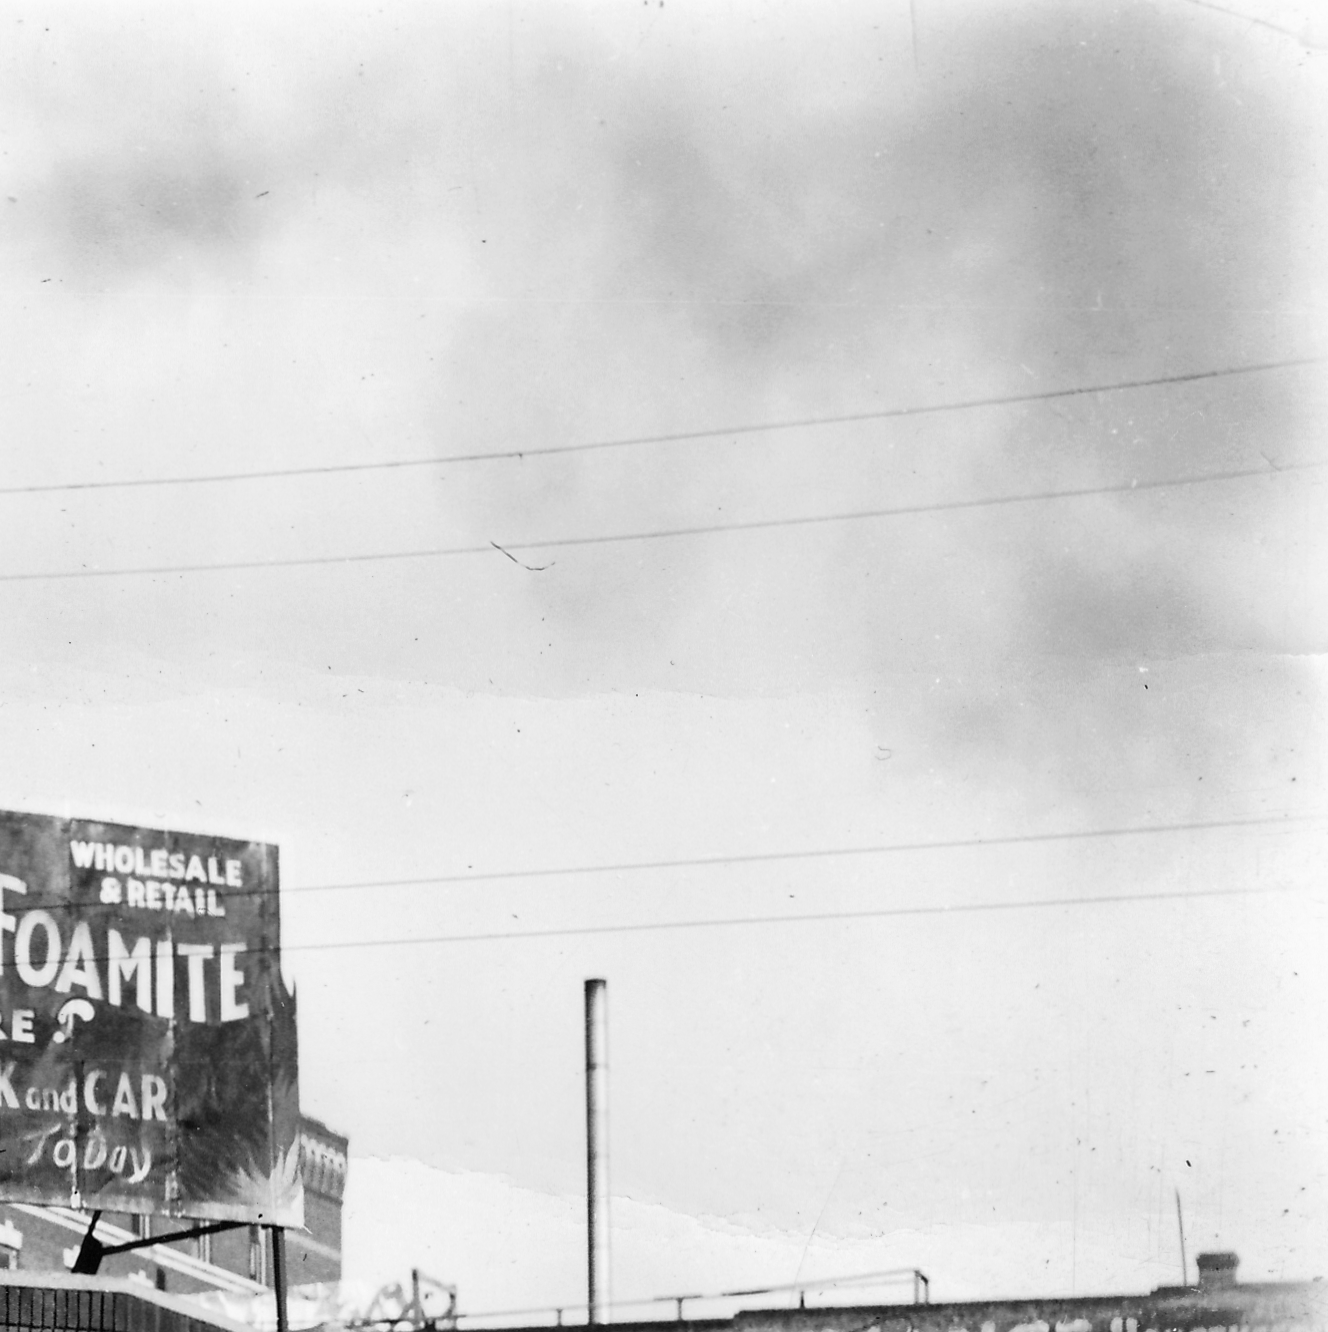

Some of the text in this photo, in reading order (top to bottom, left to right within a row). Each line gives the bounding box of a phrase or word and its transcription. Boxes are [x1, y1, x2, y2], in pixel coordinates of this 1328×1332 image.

[70, 840, 243, 887] WHOLESALE
[100, 877, 226, 917] & RETAIL
[25, 1078, 78, 1113] and
[83, 1068, 168, 1121] CAR
